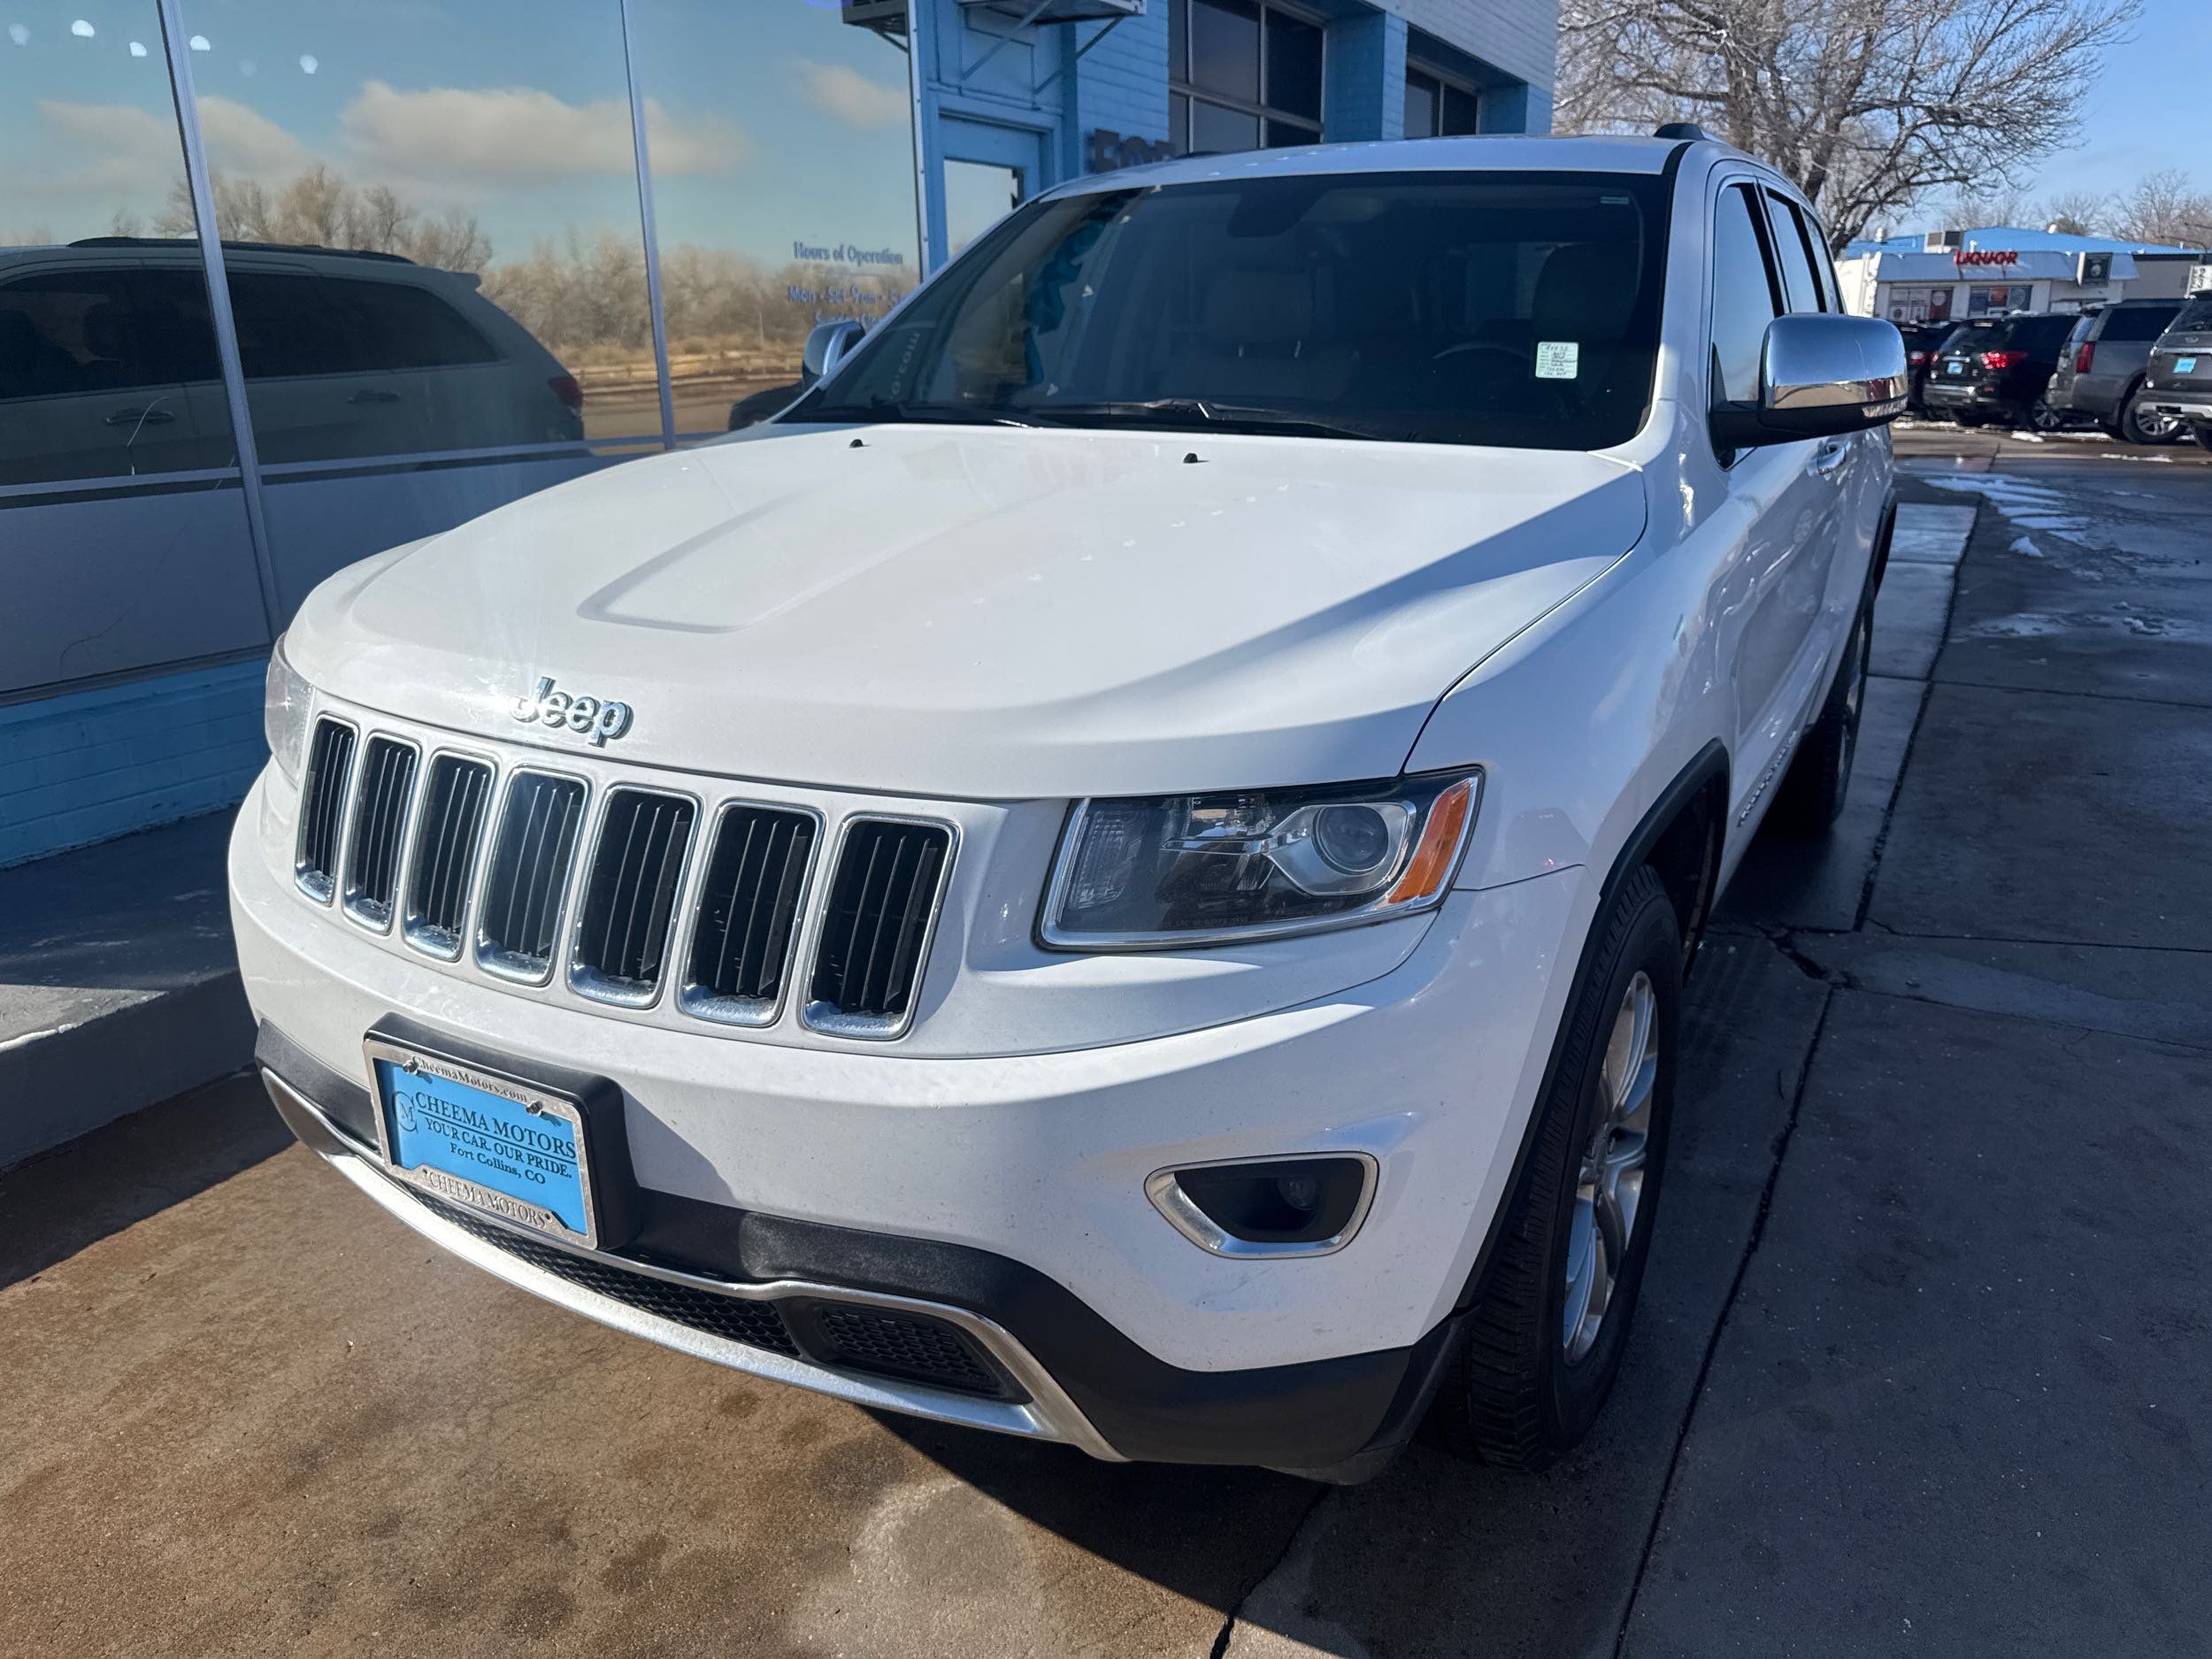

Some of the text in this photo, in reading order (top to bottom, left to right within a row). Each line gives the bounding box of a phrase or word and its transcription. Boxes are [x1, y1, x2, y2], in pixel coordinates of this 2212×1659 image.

[793, 242, 903, 266] Hours of Operation
[1954, 250, 2018, 265] LIQUOR
[511, 676, 634, 749] Jeep
[411, 1056, 527, 1102] CheemaMotors.com
[415, 1091, 576, 1159] CHEEMA MOTORS
[425, 1118, 460, 1141] YOUR
[494, 1142, 524, 1164] OUR
[527, 1152, 572, 1179] PRIDE.
[449, 1141, 546, 1185] Fort Collins, CO
[428, 1171, 547, 1229] CHEEMA MOTORS
